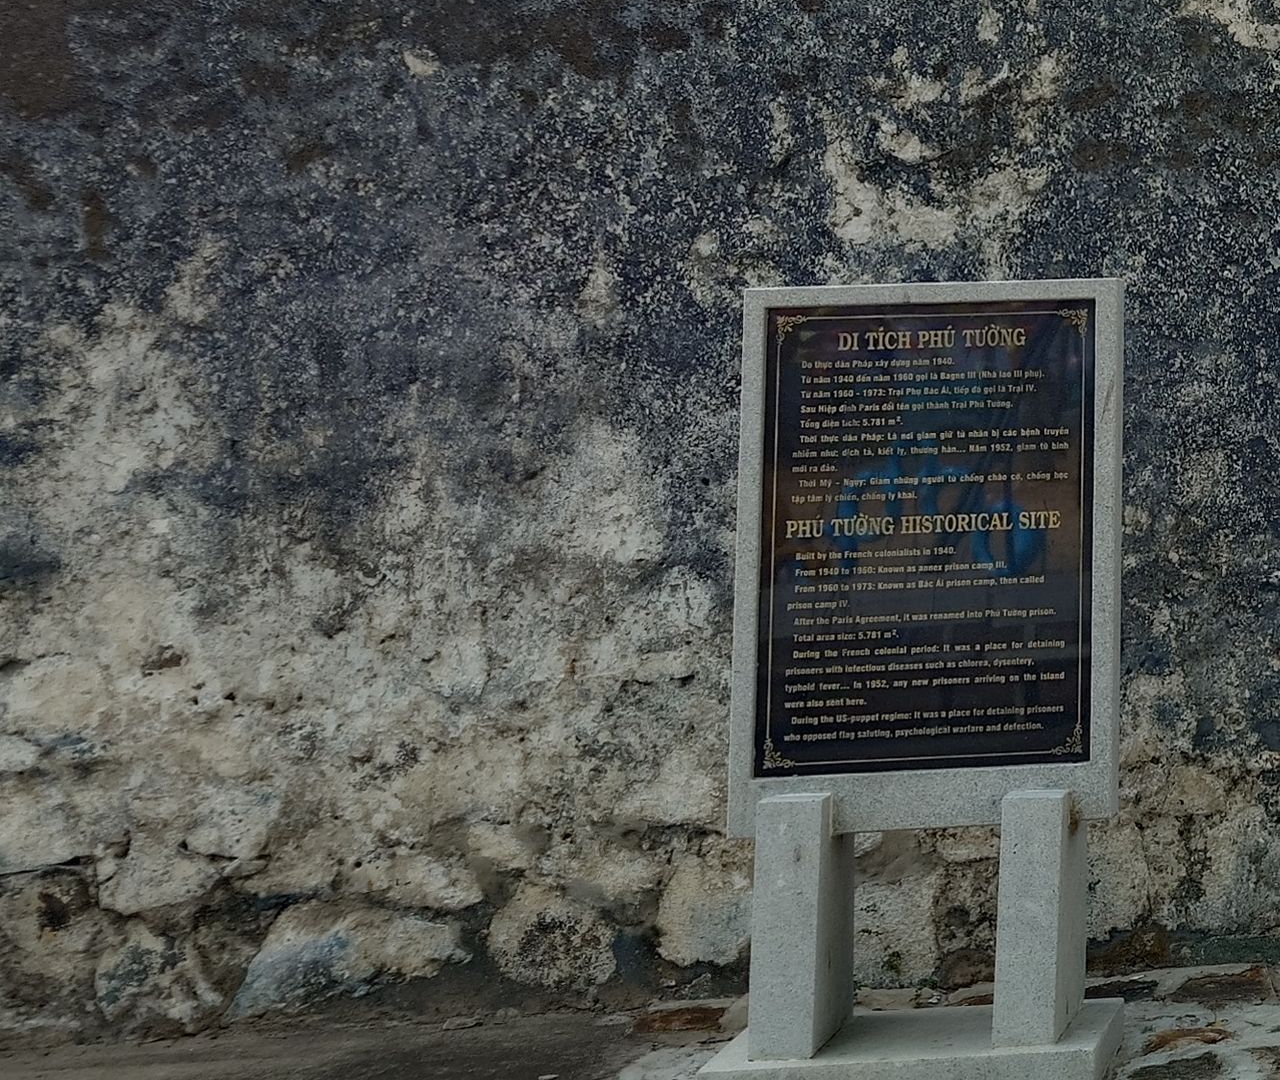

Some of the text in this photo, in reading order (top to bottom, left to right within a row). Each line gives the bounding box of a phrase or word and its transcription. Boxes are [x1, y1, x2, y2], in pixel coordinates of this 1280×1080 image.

[837, 323, 1026, 350] DI TÍCH PHÚ TƯỜNG
[785, 510, 1060, 538] PHÚ TƯỜNG HISTORICAL SITE
